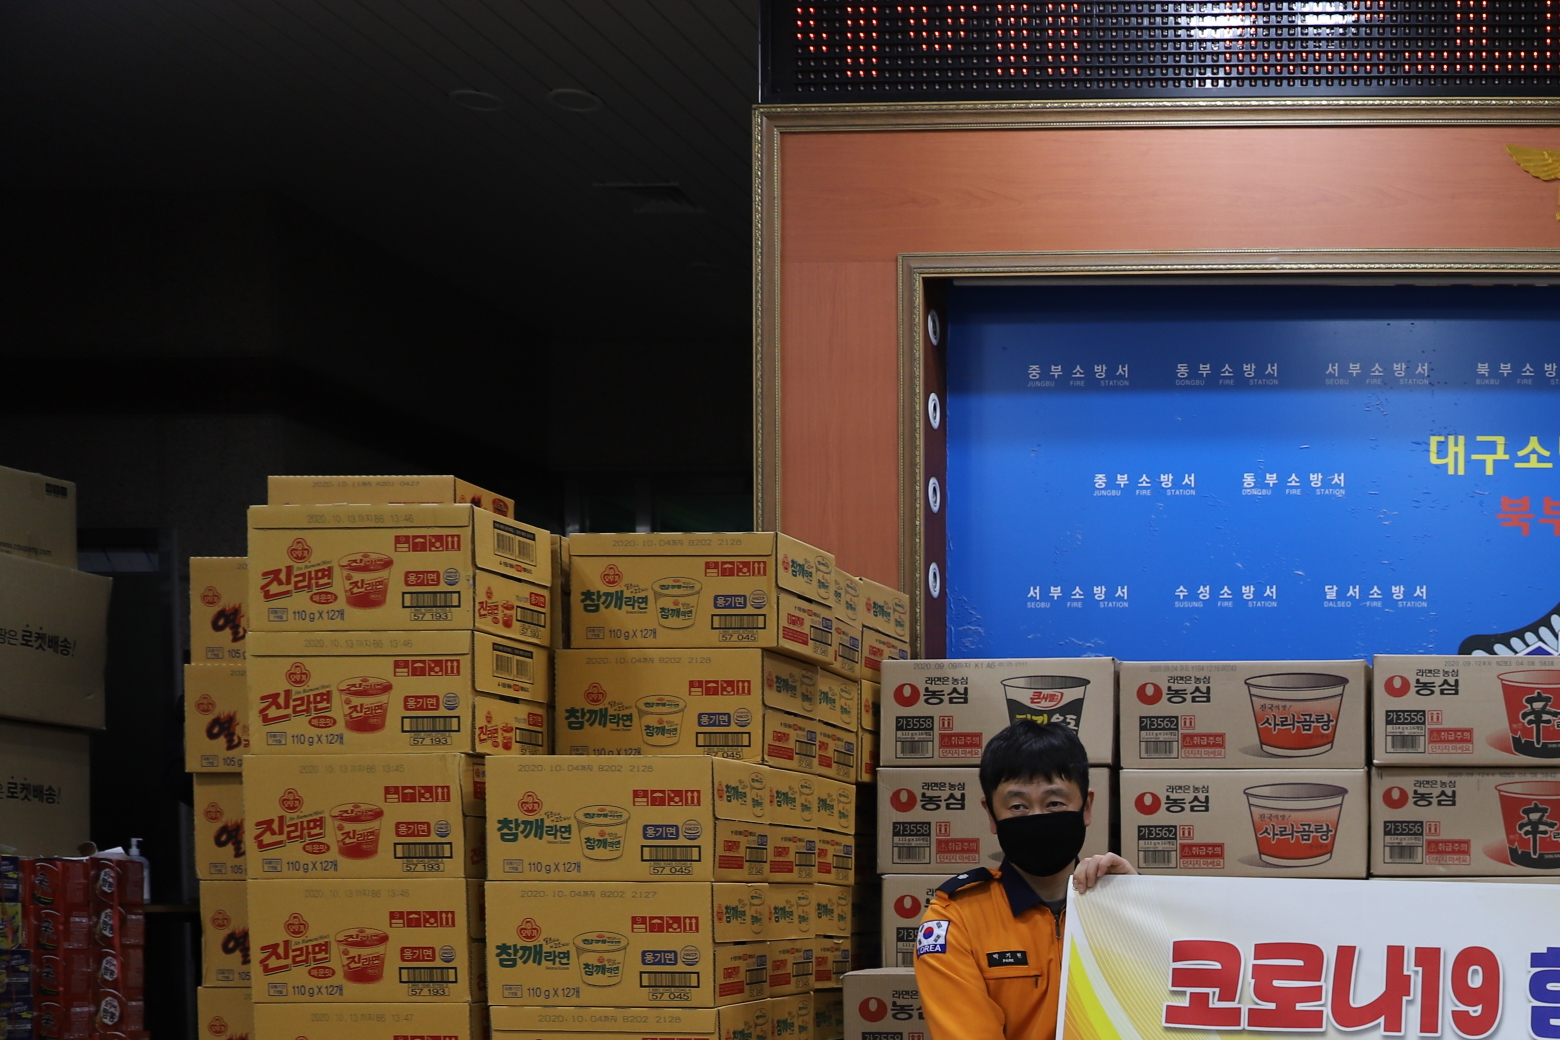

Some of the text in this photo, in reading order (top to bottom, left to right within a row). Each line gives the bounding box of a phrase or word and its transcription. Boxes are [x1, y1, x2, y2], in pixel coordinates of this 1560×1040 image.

[1027, 363, 1129, 380] 중부소방서
[1175, 362, 1278, 379] 동부소방서
[1325, 362, 1428, 378] 서부소방서
[1027, 380, 1055, 388] JUNGBU
[1100, 379, 1130, 387] STATION
[1475, 378, 1500, 386] BUKBU
[1516, 378, 1533, 386] FIRE
[1093, 472, 1195, 489] 중부소방서
[1242, 472, 1345, 489] 동부소방서
[1093, 489, 1122, 497] JUNGBU
[1166, 488, 1196, 496] STATION
[1241, 488, 1346, 497] DONGBU FIRE STATION
[260, 564, 333, 602] 진라면
[407, 573, 438, 585] 용기면
[1027, 585, 1128, 601] 서부소방서
[1174, 584, 1277, 600] 수성소방서
[1324, 584, 1427, 600] 달서소방서
[580, 590, 648, 613] 참깨라면
[716, 597, 745, 607] 용기면
[1174, 600, 1278, 608] SUSUNG FIRE STATION
[1166, 685, 1211, 704] 농심
[1414, 678, 1459, 696] 농심
[923, 687, 968, 705] 농심
[897, 718, 932, 729] 가3558
[1141, 718, 1177, 729] 가3562
[1260, 713, 1334, 734] 사리곰탕
[1387, 712, 1424, 723] 가3556
[920, 793, 965, 811] 농심
[1164, 795, 1210, 813] 농심
[1412, 790, 1456, 807] 농심
[497, 818, 572, 842] 참깨라면
[645, 827, 676, 838] 용기면
[894, 824, 929, 834] 가3558
[1139, 827, 1175, 838] 가3562
[1259, 822, 1334, 843] 사리곰탕
[1386, 823, 1422, 834] 가3556
[1517, 802, 1558, 858] 辛
[1163, 939, 1502, 1037] 코로나19
